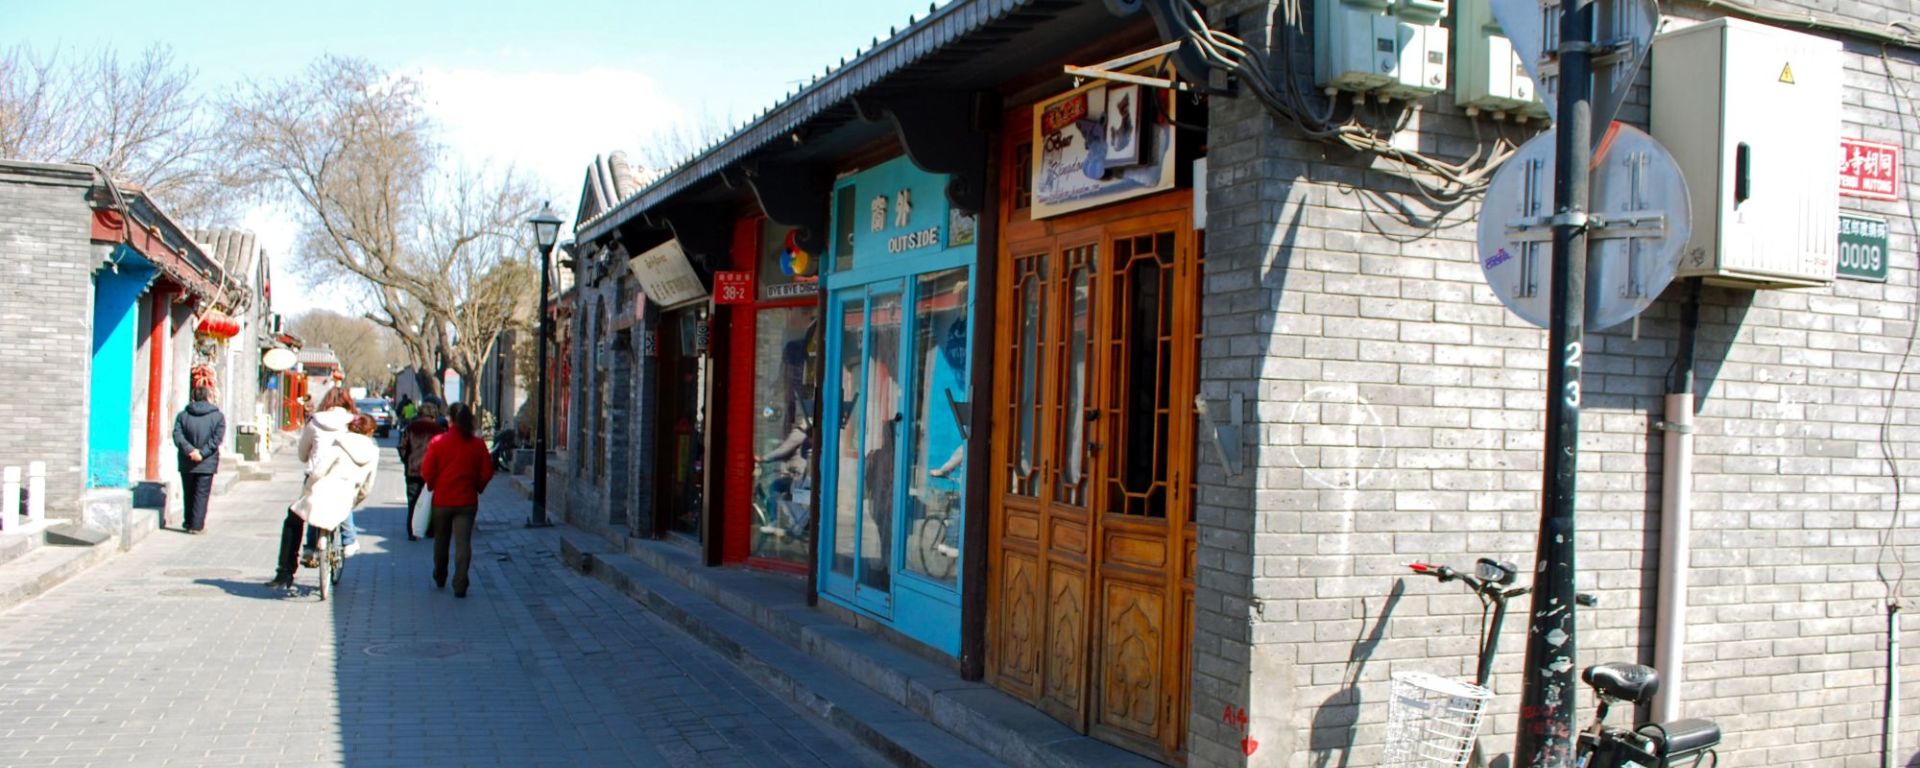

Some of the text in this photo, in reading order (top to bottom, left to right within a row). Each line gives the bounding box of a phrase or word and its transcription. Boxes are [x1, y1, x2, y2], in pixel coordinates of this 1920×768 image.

[1048, 156, 1085, 180] Kingdo
[1863, 177, 1892, 192] HUTONG
[1839, 217, 1890, 239] 区邮政编码
[888, 227, 939, 253] OUTSIDE
[1840, 241, 1881, 271] 0009
[722, 286, 745, 300] 38-2
[768, 283, 818, 297] BYE BYE DISC
